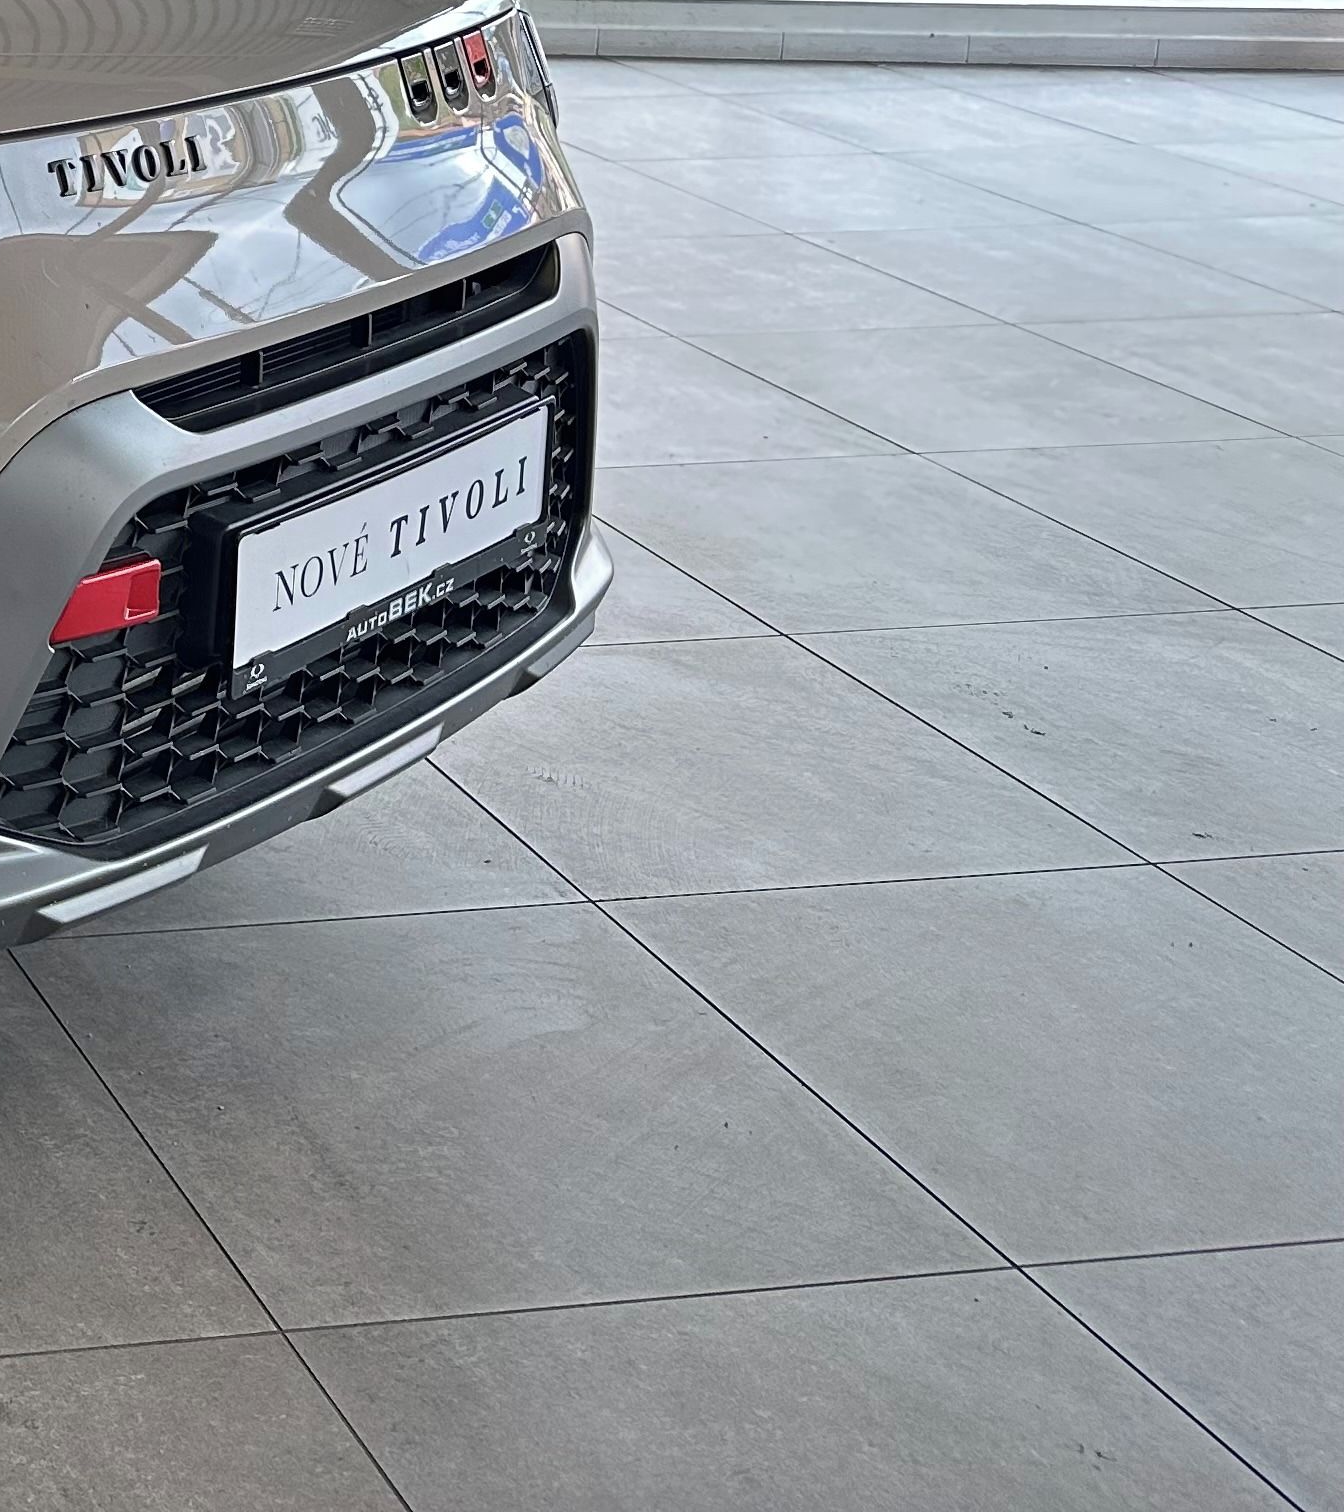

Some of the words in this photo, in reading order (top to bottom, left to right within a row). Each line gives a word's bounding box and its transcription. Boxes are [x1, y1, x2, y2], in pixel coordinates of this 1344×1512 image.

[47, 135, 207, 198] TIVOLI
[272, 522, 369, 613] NOVÉ
[389, 455, 528, 559] TIVOLI
